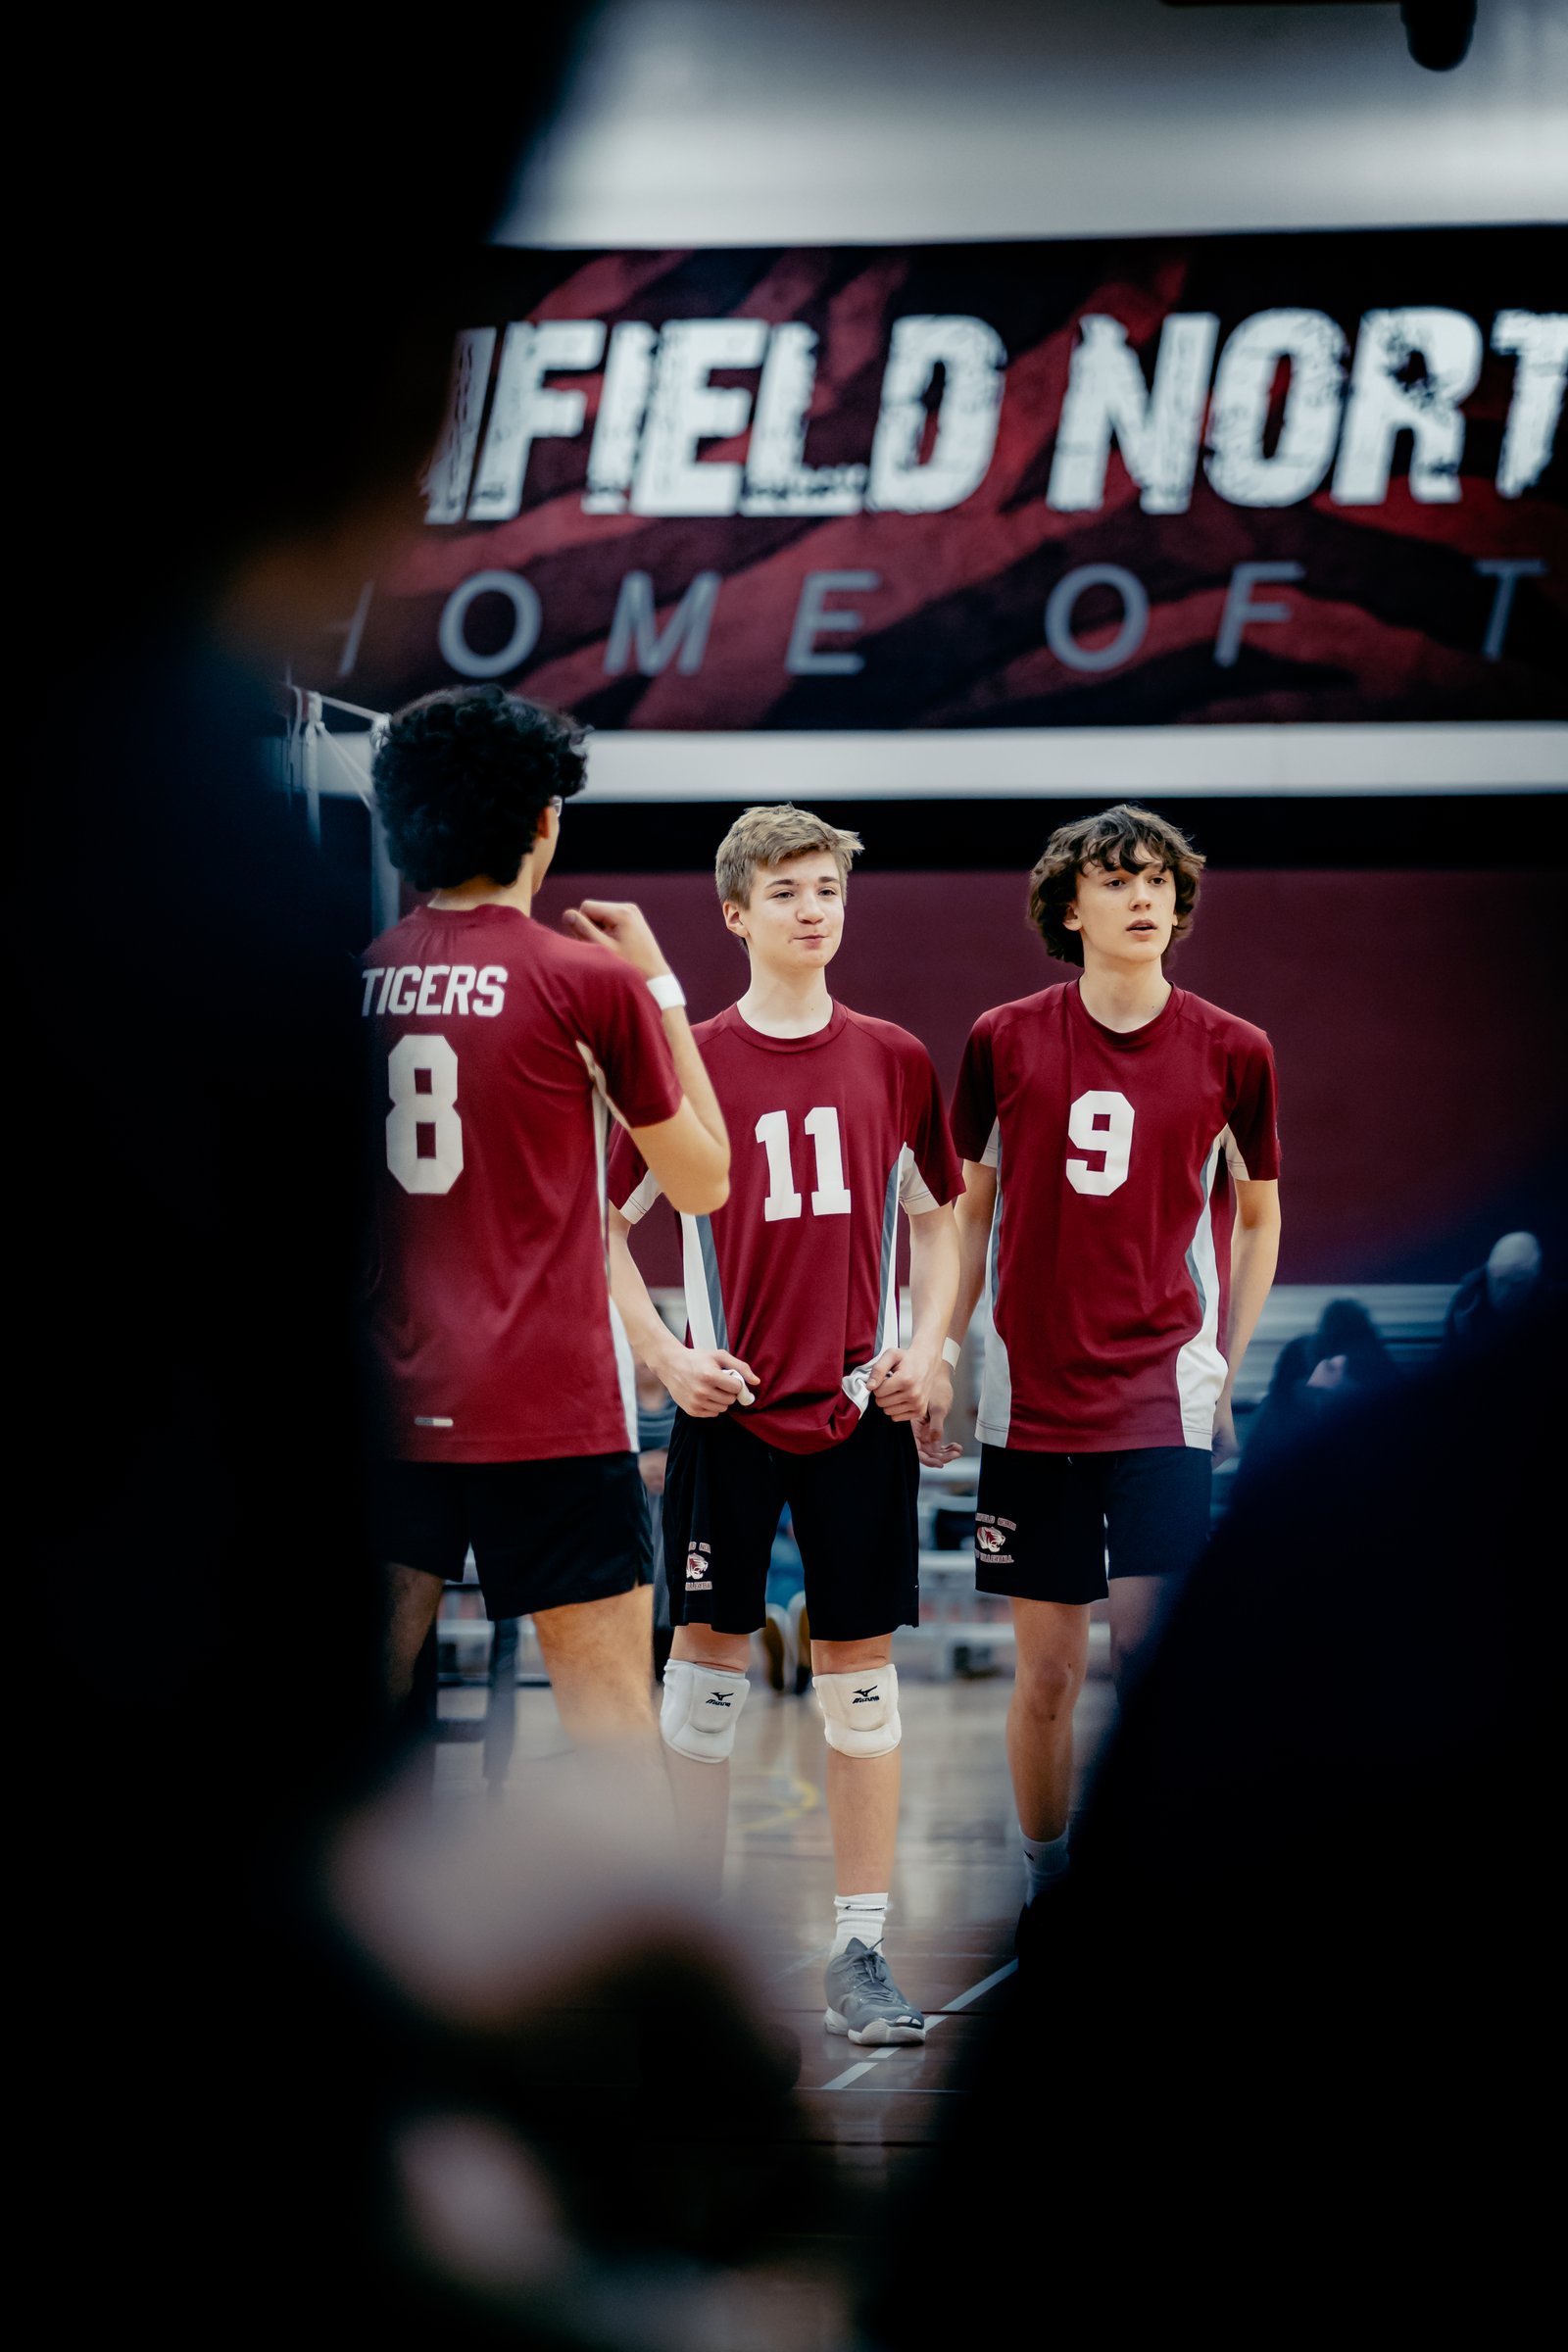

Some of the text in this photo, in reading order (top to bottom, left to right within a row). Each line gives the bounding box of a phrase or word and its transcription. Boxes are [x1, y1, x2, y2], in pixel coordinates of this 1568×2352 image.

[1046, 306, 1568, 514] NORT
[1044, 561, 1306, 672] OF
[362, 964, 509, 1017] TIGERS
[386, 1034, 464, 1196] 8
[754, 1106, 852, 1223] 11
[1065, 1090, 1136, 1198] 9
